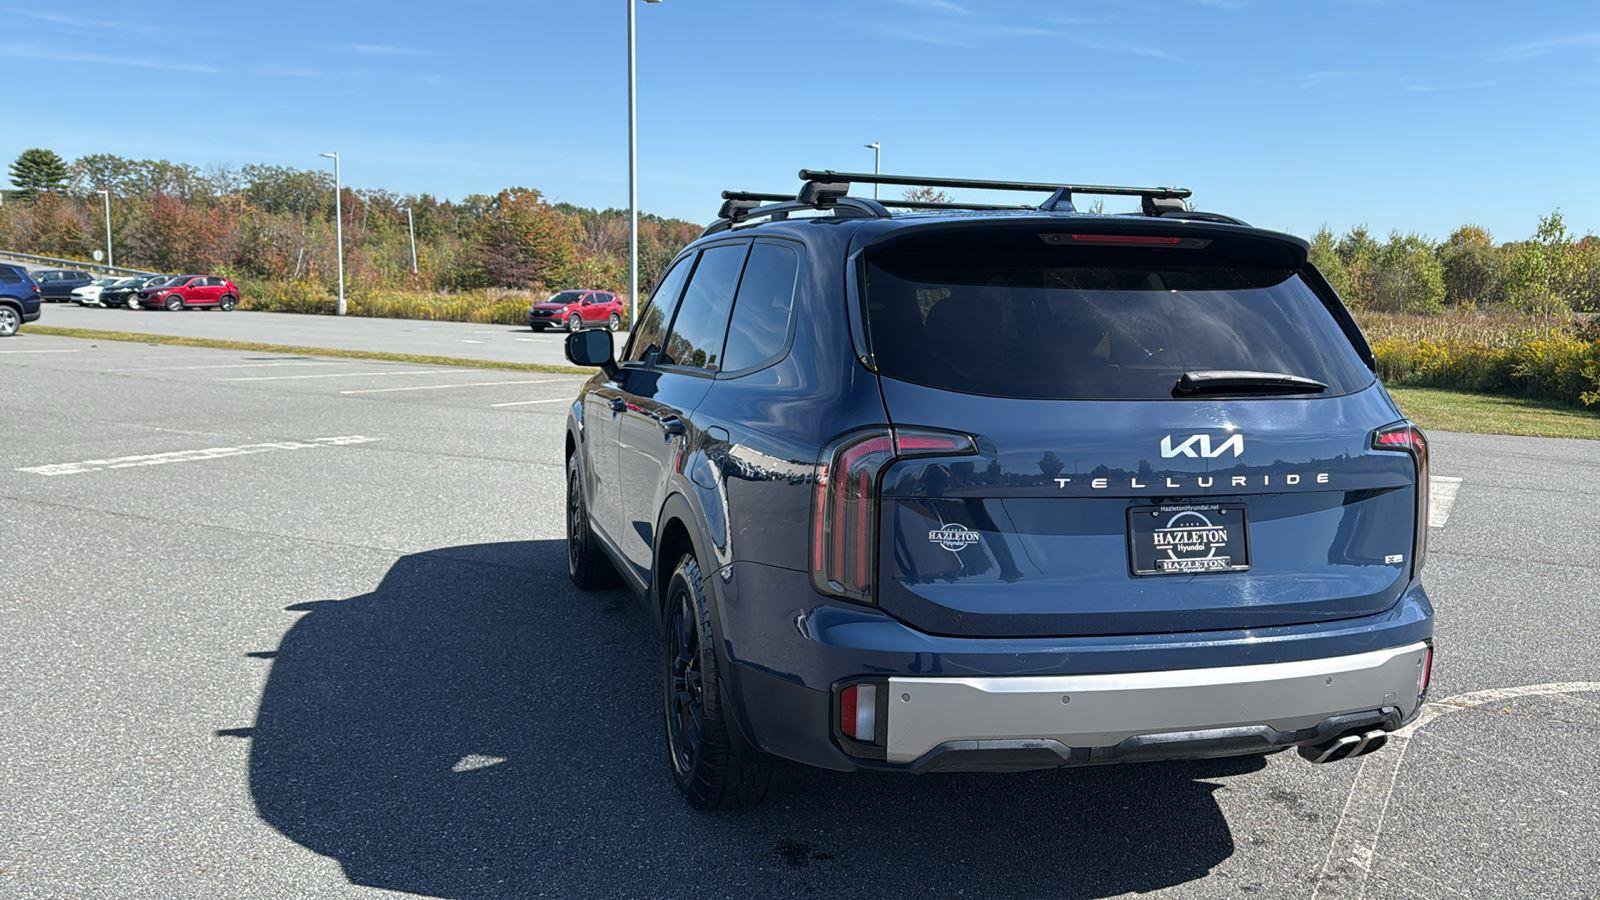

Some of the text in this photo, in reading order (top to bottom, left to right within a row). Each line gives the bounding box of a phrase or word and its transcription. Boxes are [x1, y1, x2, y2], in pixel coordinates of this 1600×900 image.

[1054, 473, 1329, 489] TELLURIDE
[928, 532, 980, 541] HAZLETON
[1153, 530, 1228, 545] HAZLETON
[1177, 543, 1205, 553] Hyundai
[1163, 560, 1226, 569] HAZLETON
